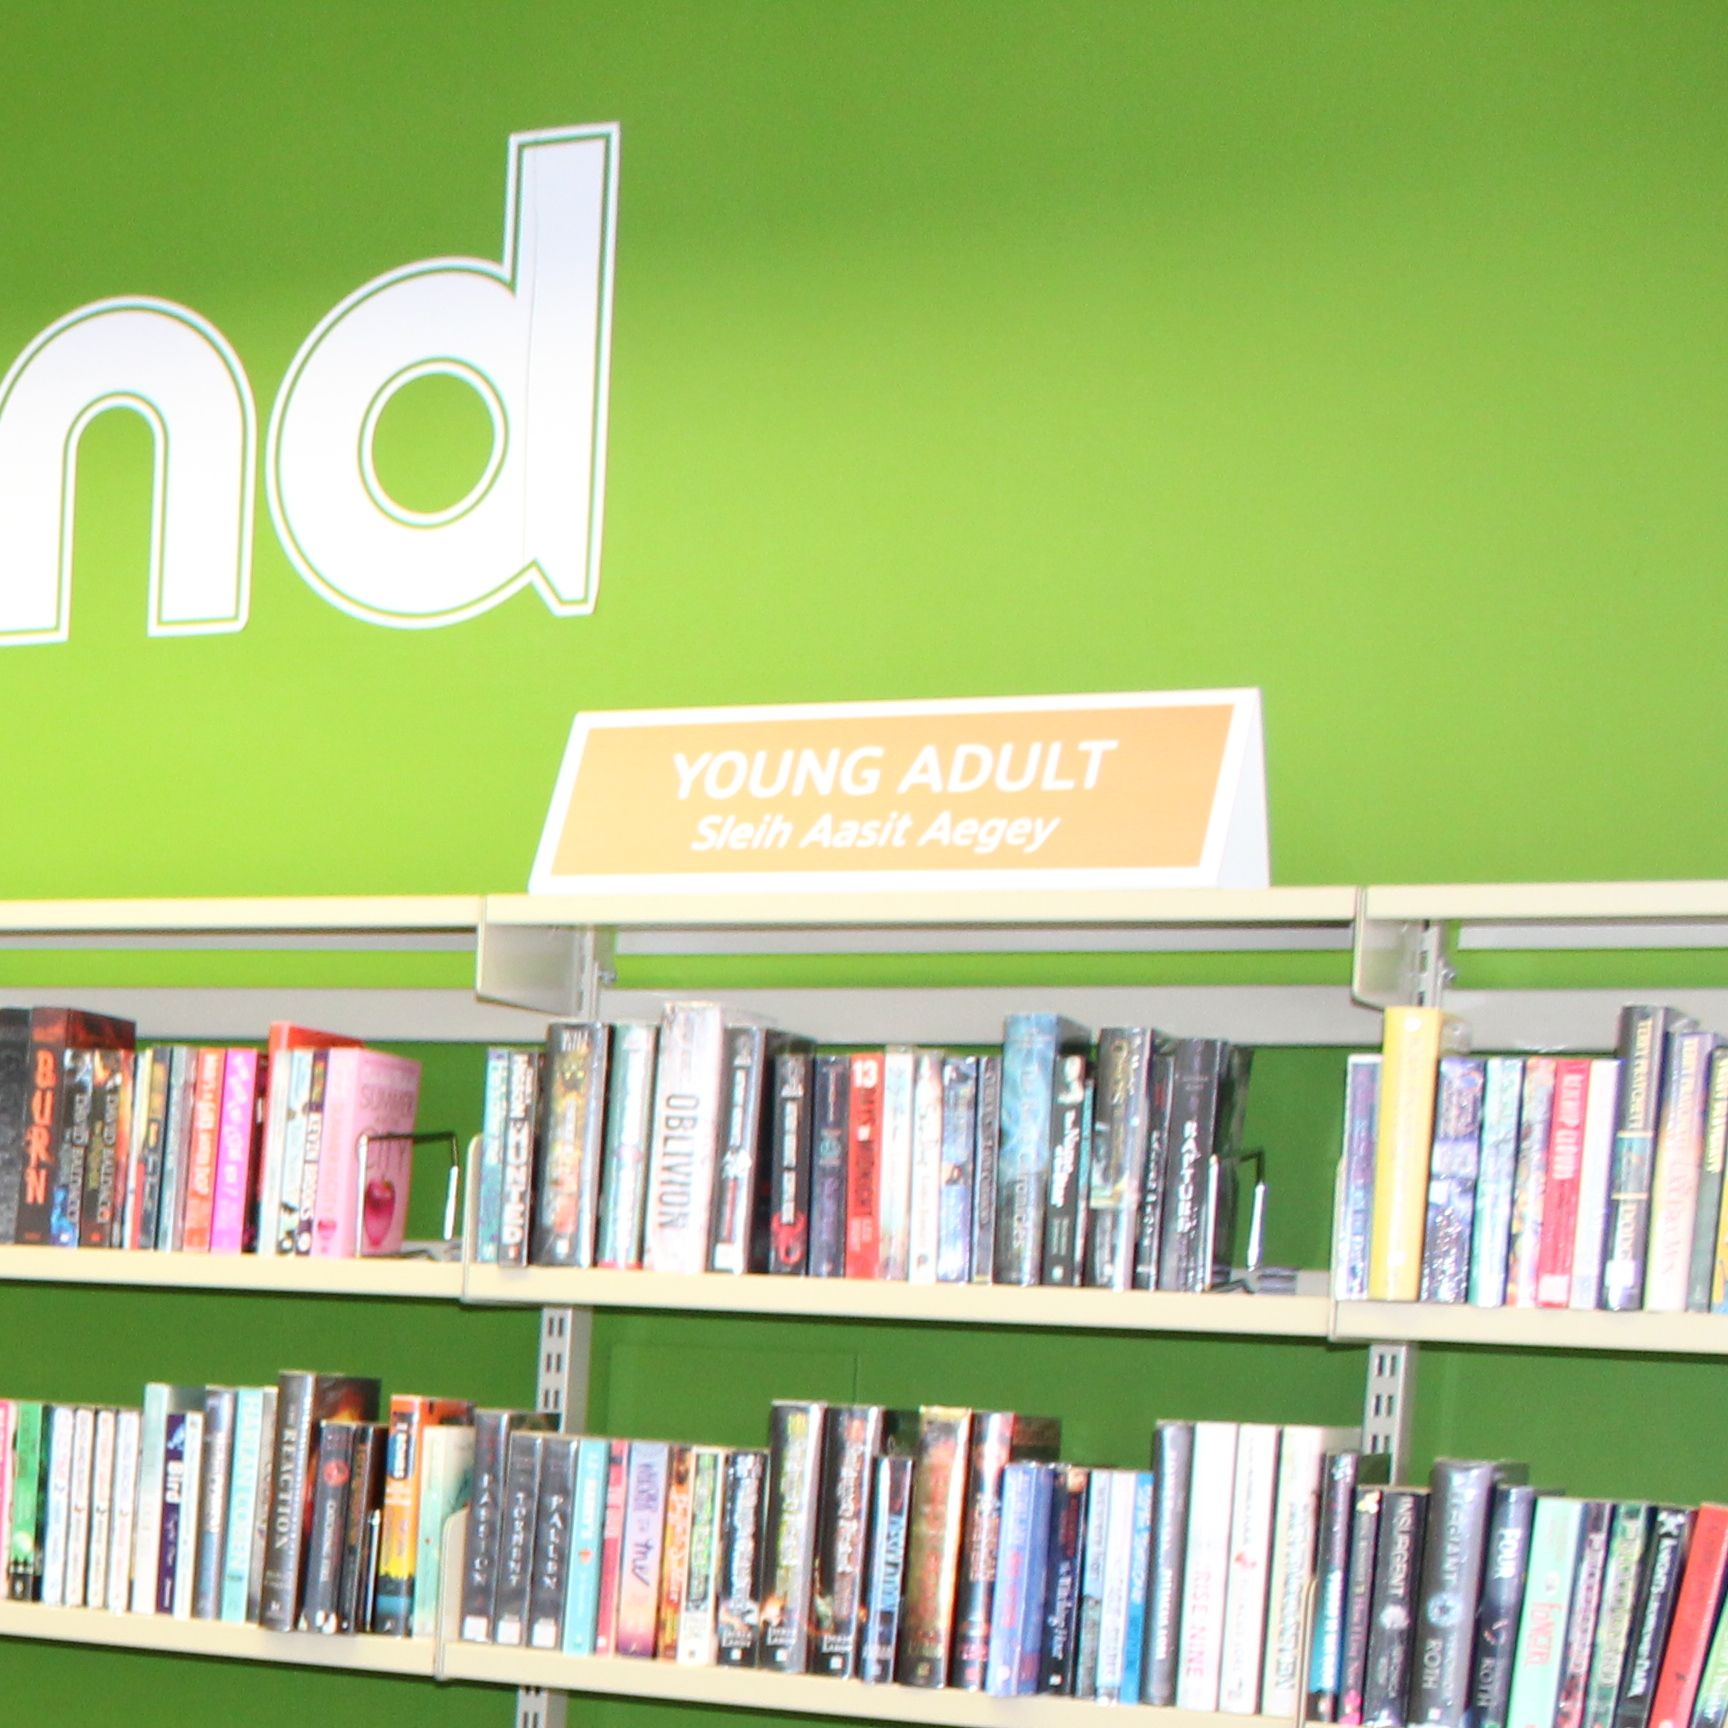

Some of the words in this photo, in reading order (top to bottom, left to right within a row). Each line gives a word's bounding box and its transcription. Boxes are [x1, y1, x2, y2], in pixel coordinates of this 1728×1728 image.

[671, 746, 884, 800] YOUNG
[898, 739, 1120, 795] ADULT
[691, 812, 793, 853] Sleih
[800, 812, 912, 850] Aasit
[918, 809, 1061, 854] Aegey
[24, 1050, 56, 1205] BURN
[306, 1113, 321, 1159] KEVIN
[658, 1093, 701, 1229] OBLIVION
[300, 1163, 320, 1220] BROOKS
[164, 1460, 185, 1502] Bird
[275, 1427, 296, 1548] REACTION
[1387, 1497, 1415, 1597] INSURGENT
[1493, 1528, 1521, 1578] FOUR
[1420, 1638, 1442, 1689] ROTH
